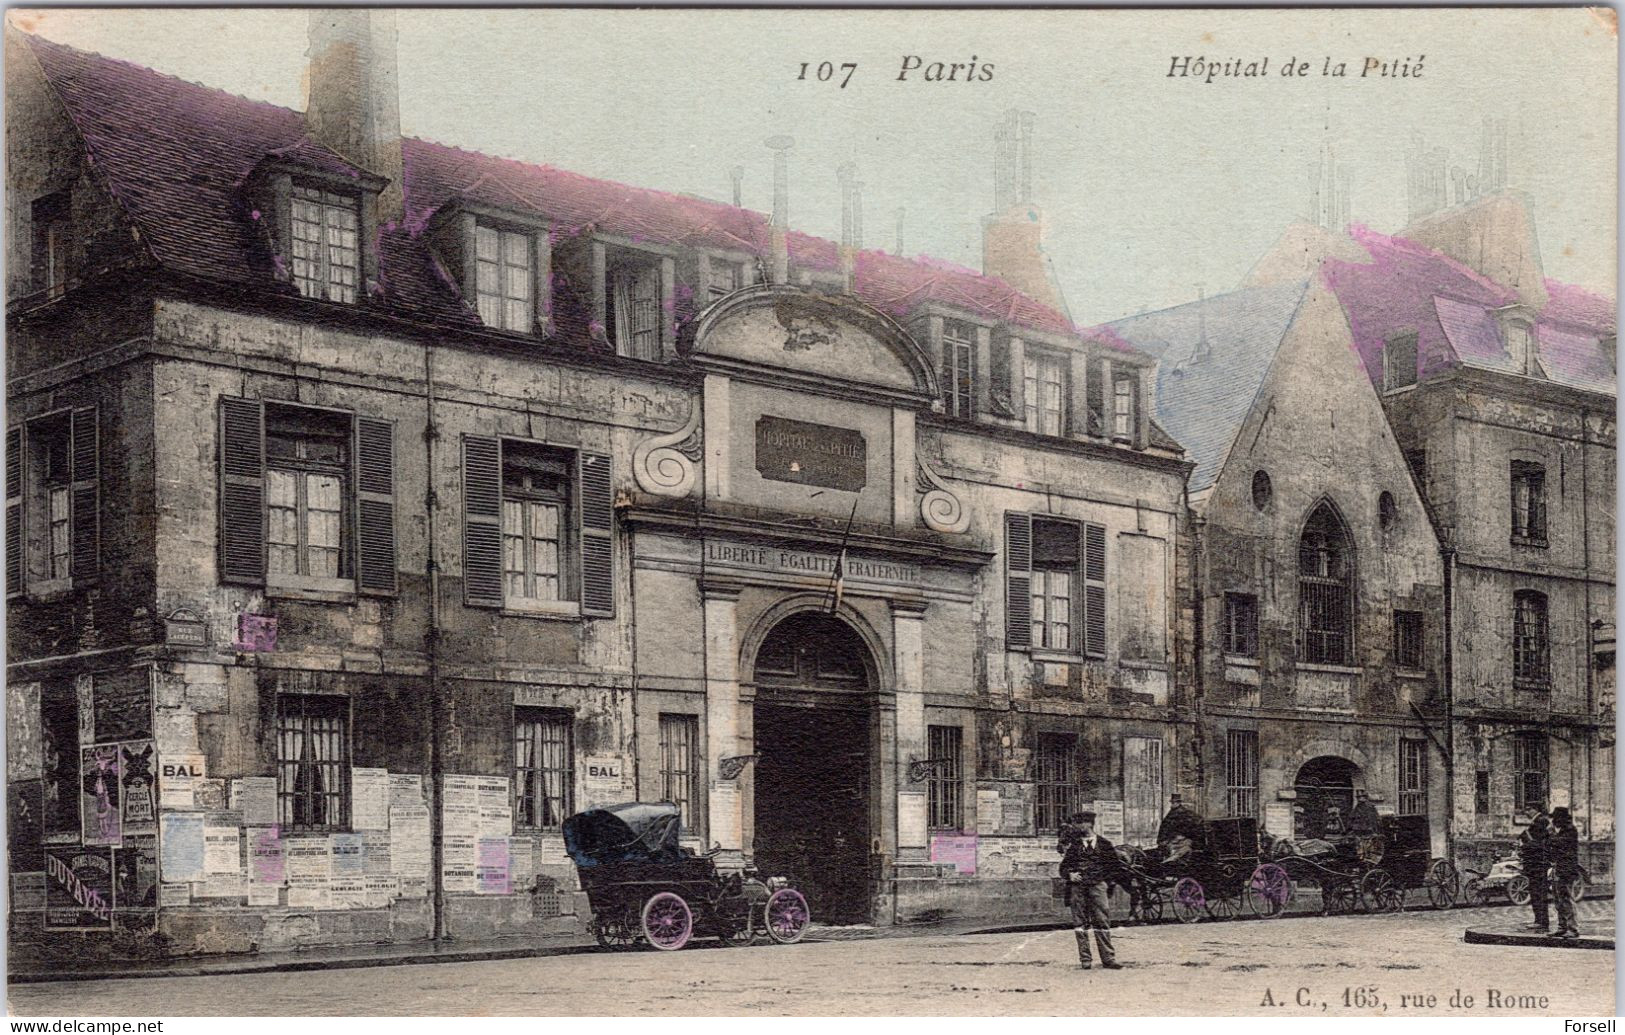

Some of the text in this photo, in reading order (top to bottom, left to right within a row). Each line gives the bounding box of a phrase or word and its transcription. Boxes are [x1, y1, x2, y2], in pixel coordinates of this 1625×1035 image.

[708, 546, 767, 565] LIBERTÉ
[780, 551, 836, 573] ÉGALITÉ
[162, 765, 202, 777] BAL
[589, 766, 619, 777] BAL
[47, 853, 110, 921] DUFAYEL
